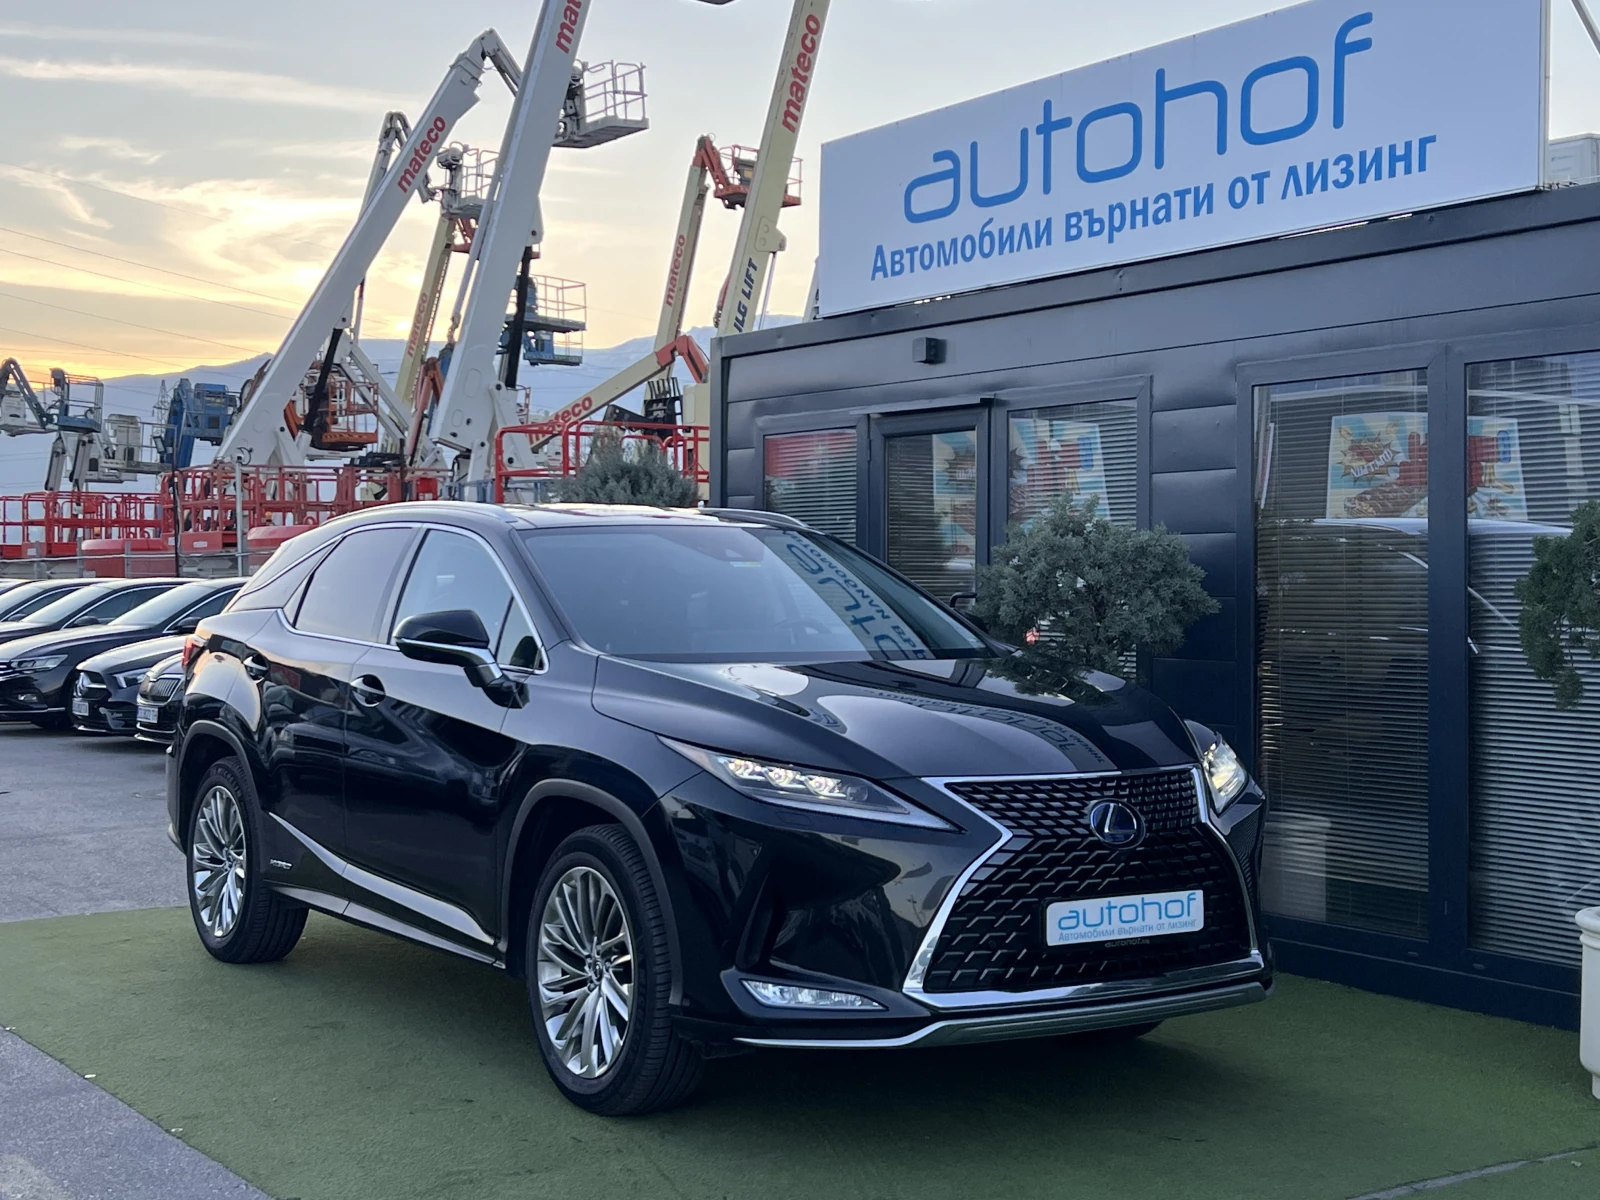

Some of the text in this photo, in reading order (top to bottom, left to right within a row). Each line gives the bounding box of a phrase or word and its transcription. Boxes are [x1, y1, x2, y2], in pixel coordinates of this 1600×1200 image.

[781, 14, 820, 134] mateco
[397, 116, 446, 193] mateco
[903, 11, 1374, 224] autohof
[870, 133, 1438, 281] Автомобили върнати от лизинг
[741, 257, 758, 301] LIFT
[1057, 892, 1196, 931] autohof
[1058, 919, 1198, 943] Автомобили върнати от лизинг
